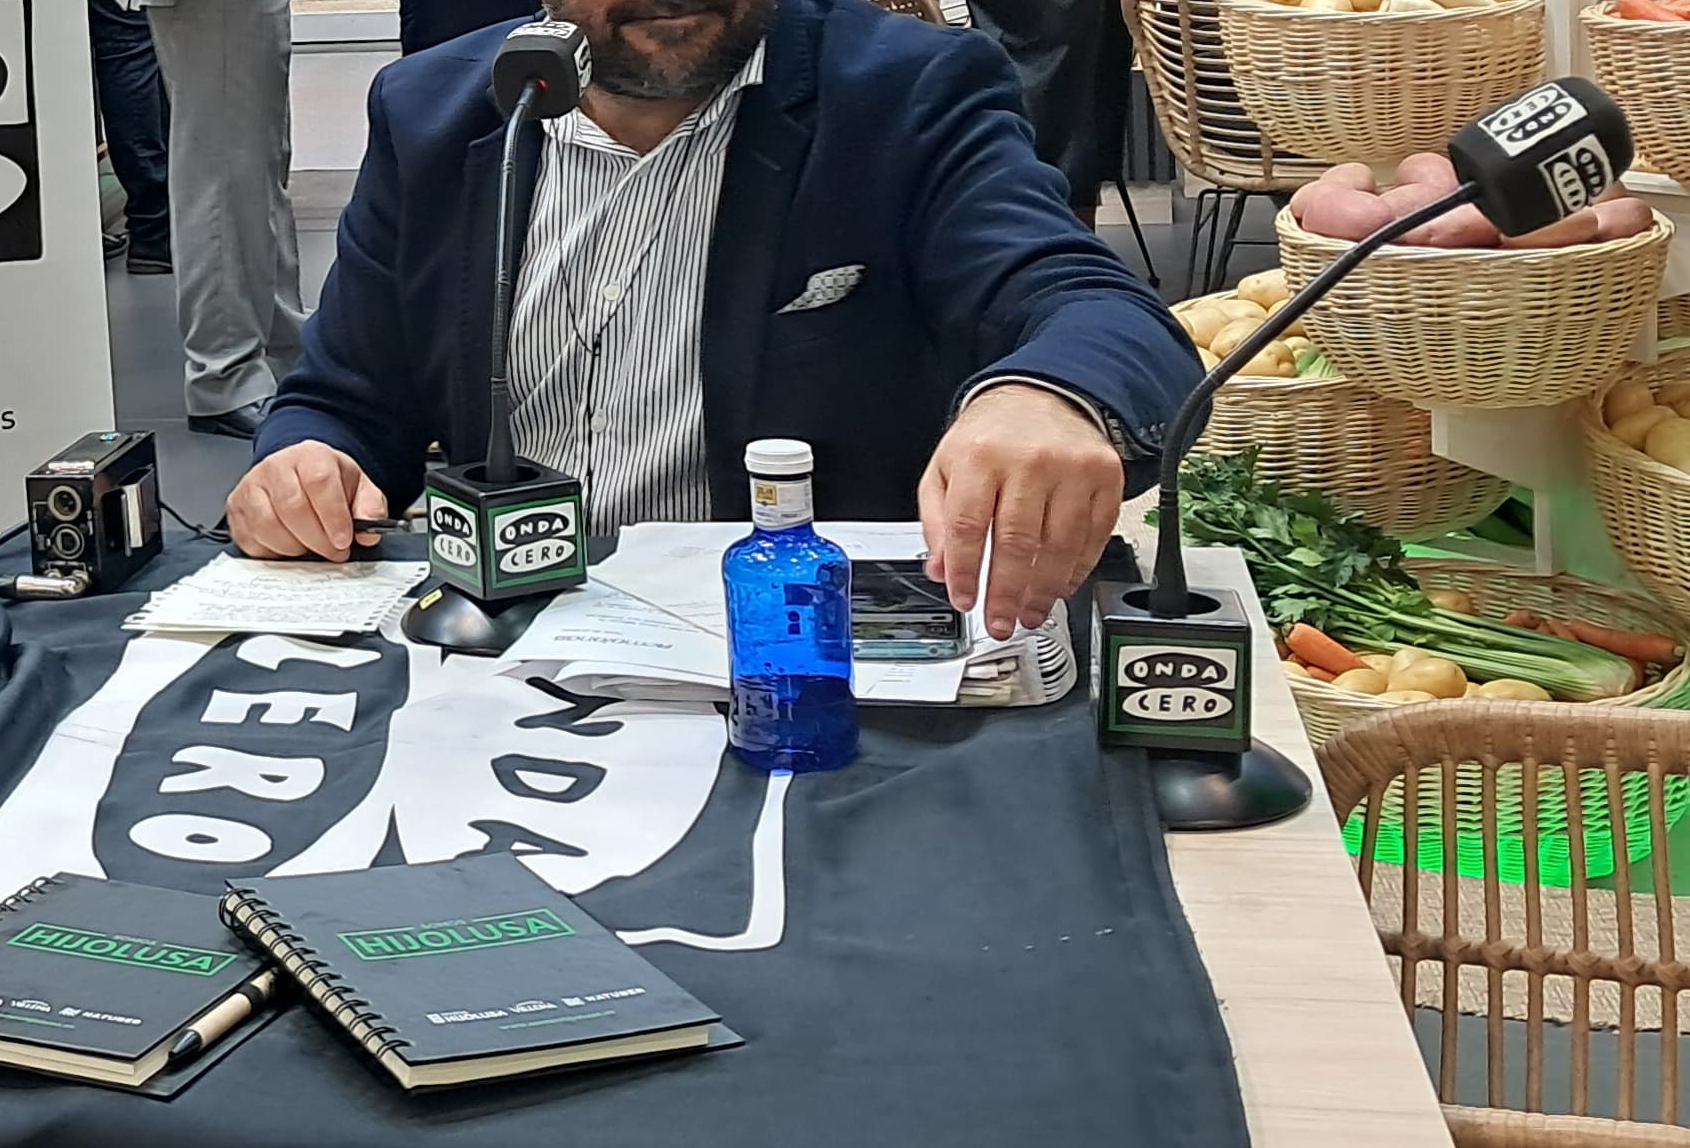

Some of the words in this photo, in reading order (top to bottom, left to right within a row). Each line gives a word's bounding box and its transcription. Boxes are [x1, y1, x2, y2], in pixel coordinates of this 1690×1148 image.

[1512, 105, 1569, 139] ONDA
[1579, 151, 1604, 197] ONDA
[436, 510, 470, 535] ONDA
[505, 518, 564, 540] ONDA
[440, 538, 471, 562] CERO
[511, 545, 565, 566] CERO
[1133, 661, 1218, 680] ONDA
[1138, 694, 1217, 712] CERO
[468, 676, 625, 858] NDA
[357, 917, 559, 954] HIJOLUSA
[24, 929, 213, 970] HIJOLUSA
